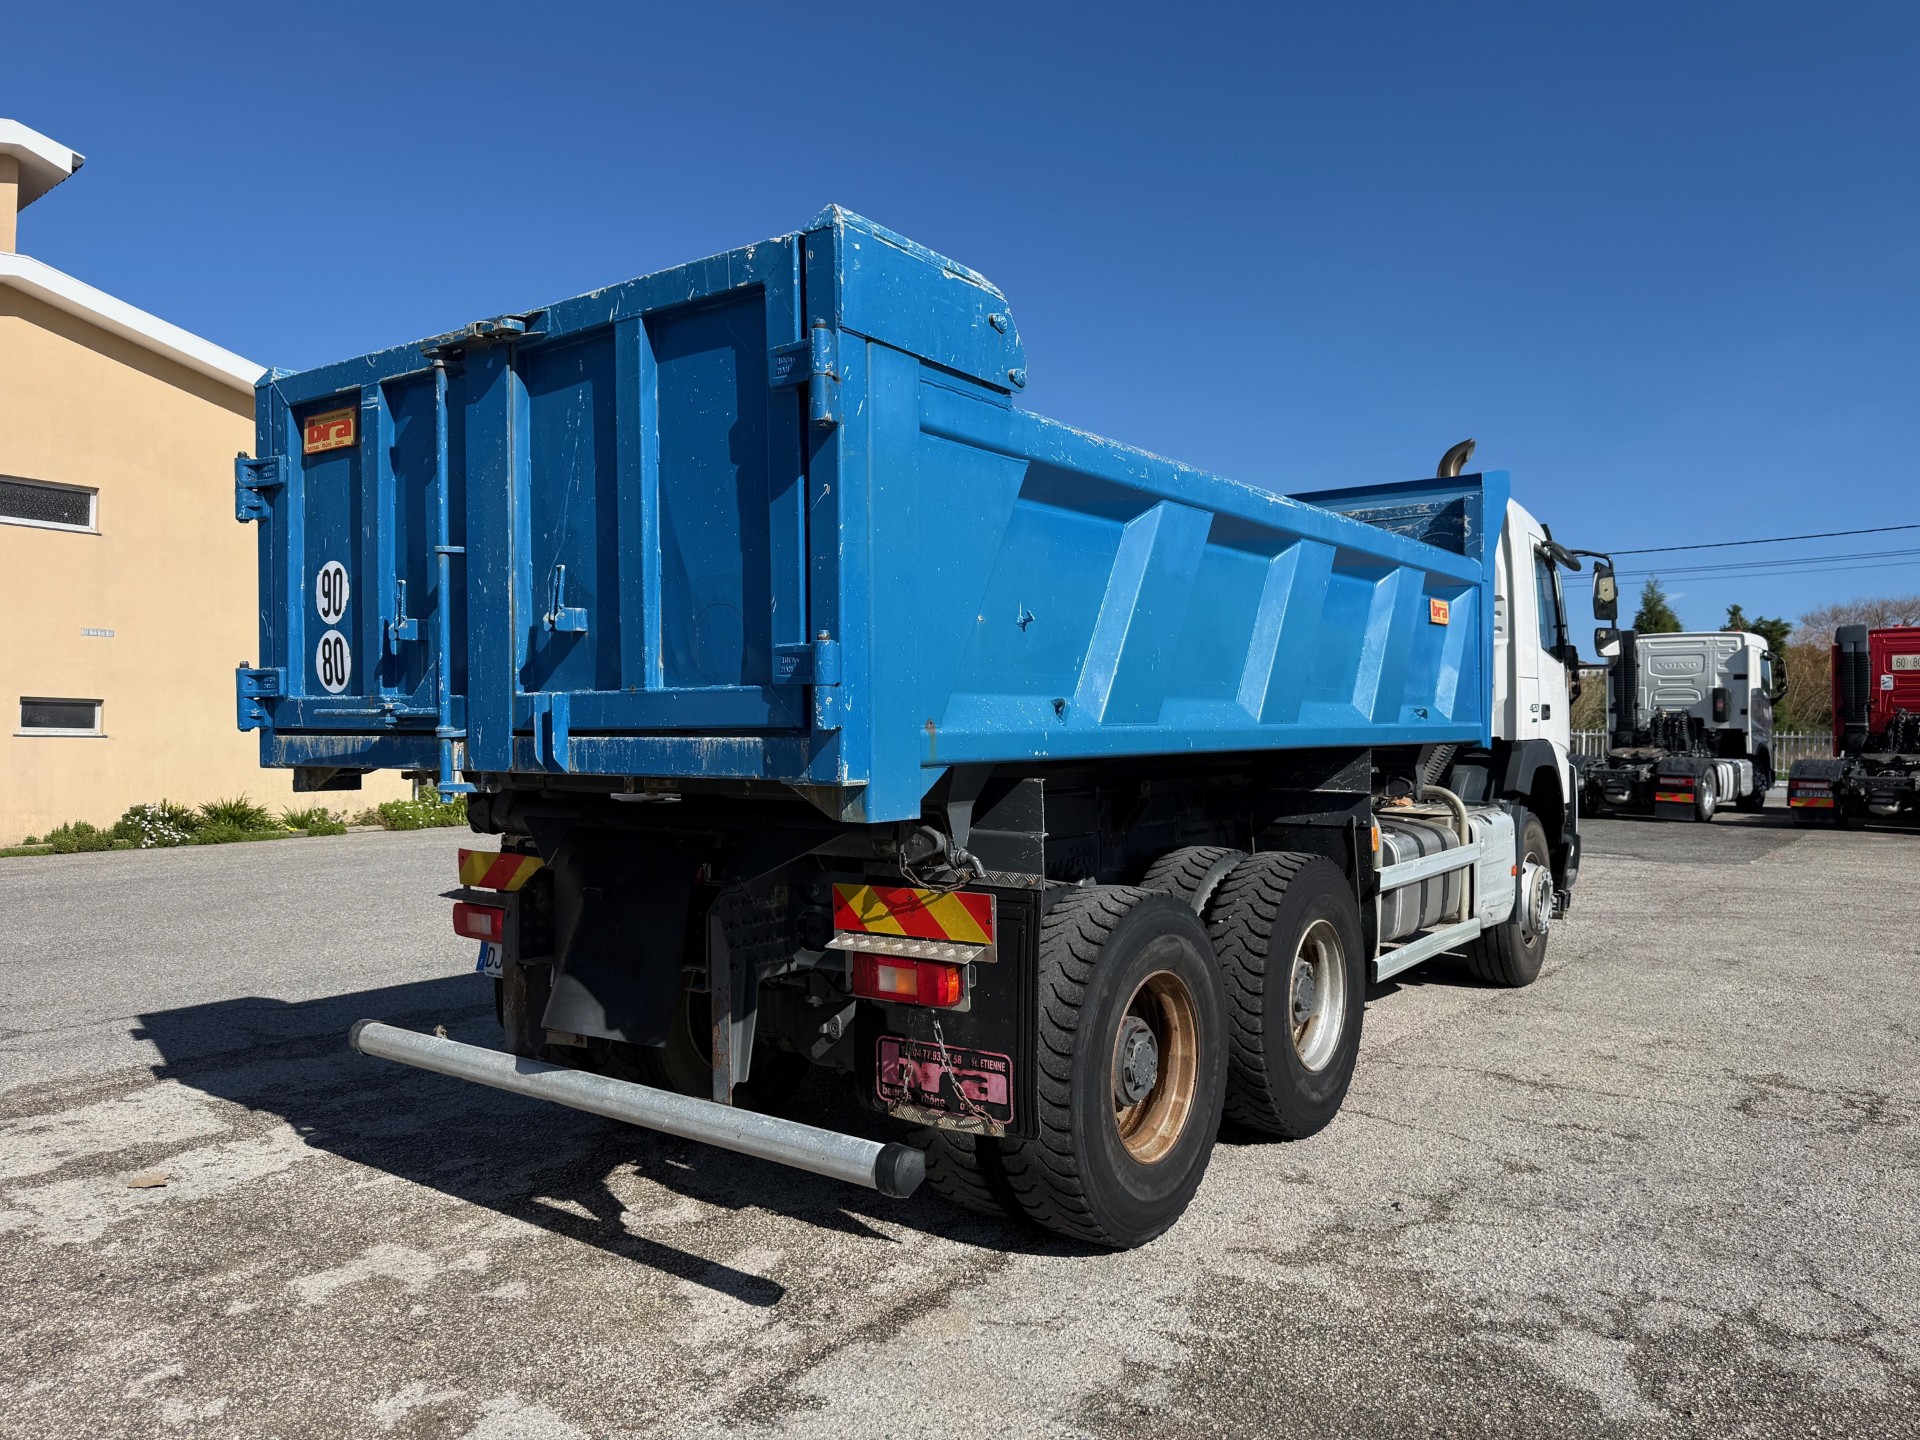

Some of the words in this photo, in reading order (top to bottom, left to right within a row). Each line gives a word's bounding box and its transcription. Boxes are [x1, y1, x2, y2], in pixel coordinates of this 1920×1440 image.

[321, 567, 343, 618] 90
[1432, 600, 1448, 619] bra
[321, 637, 345, 687] 80
[1656, 662, 1698, 670] VOLVO
[1896, 657, 1906, 668] 60
[980, 1059, 1006, 1073] ETIENNE
[921, 1093, 946, 1108] rhône
